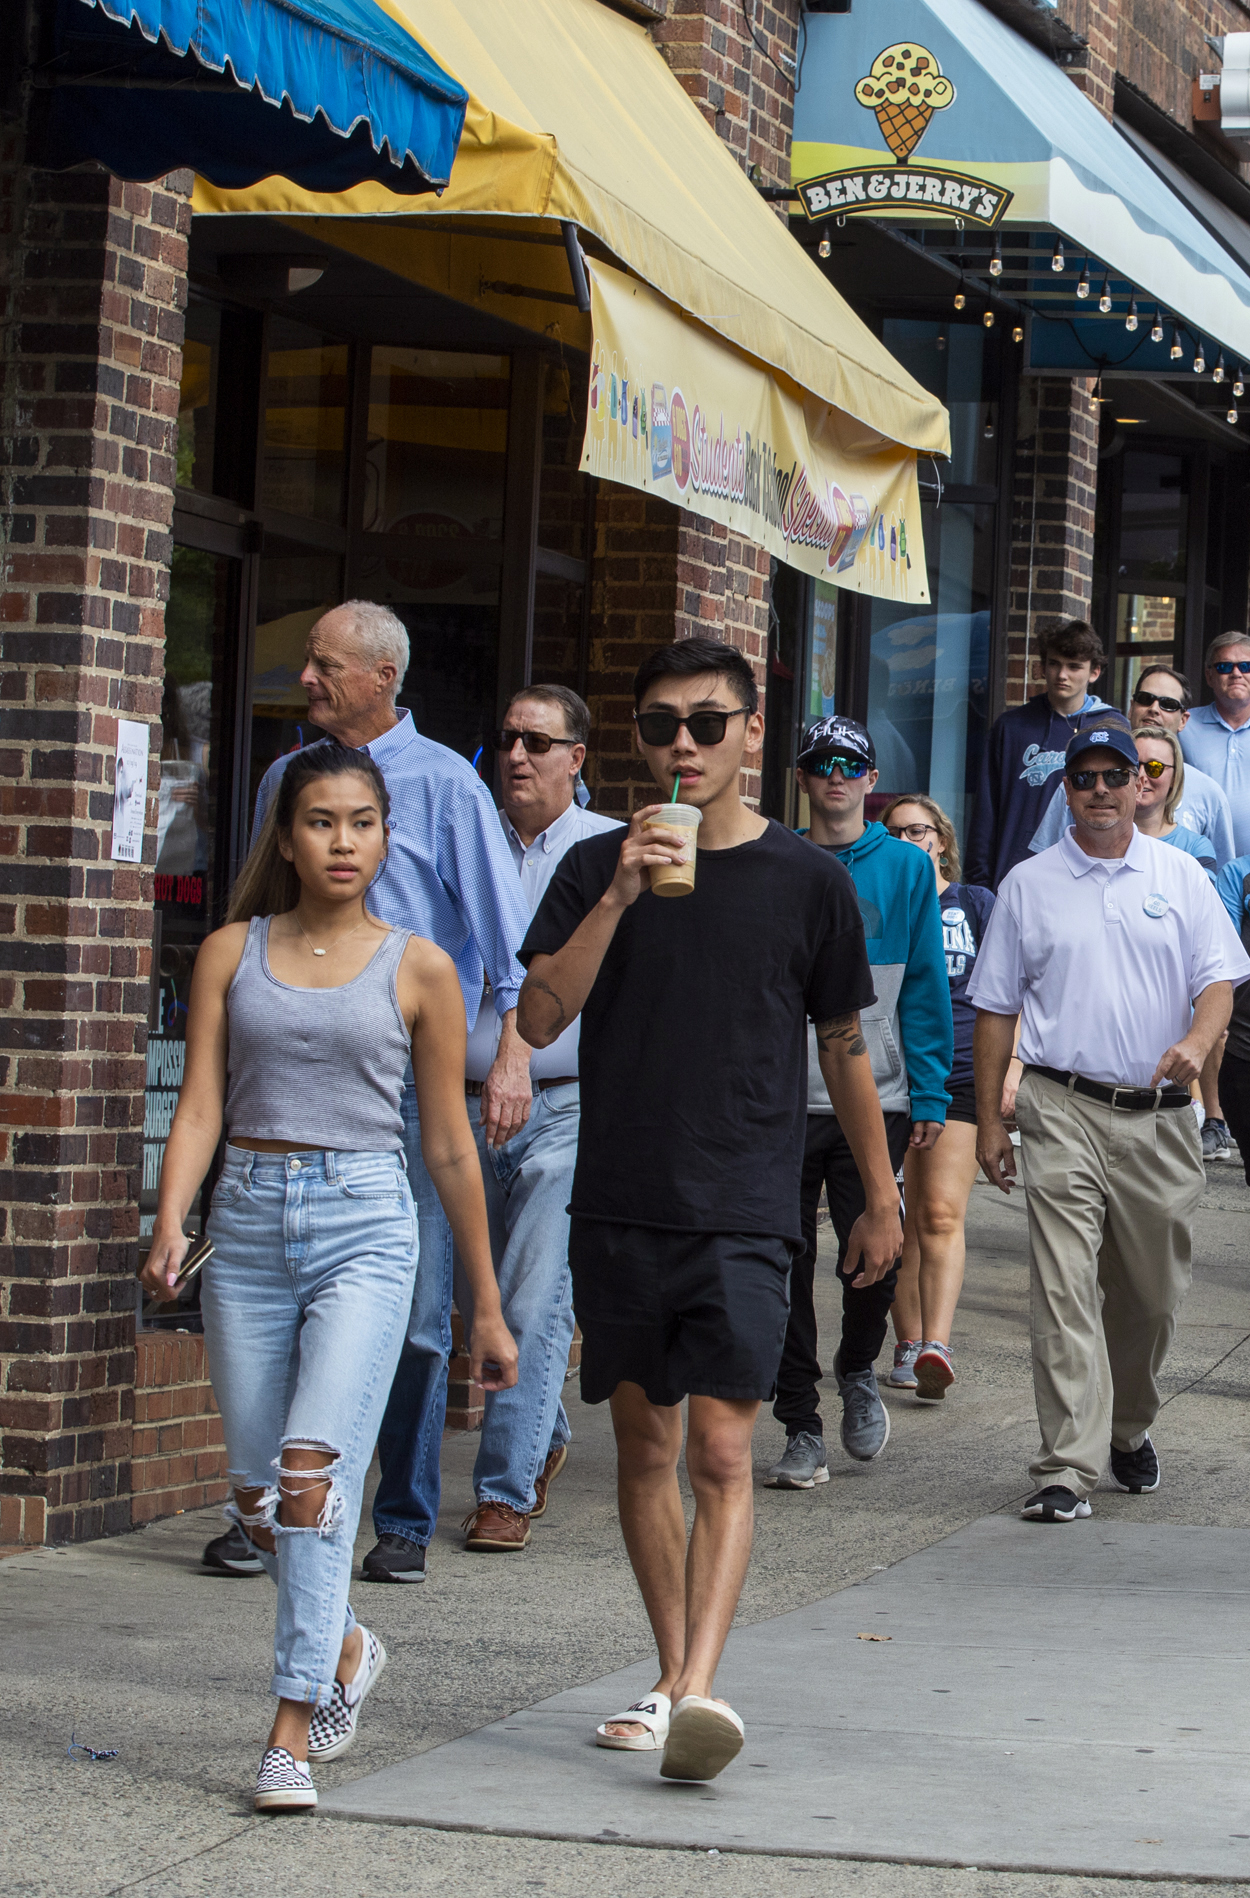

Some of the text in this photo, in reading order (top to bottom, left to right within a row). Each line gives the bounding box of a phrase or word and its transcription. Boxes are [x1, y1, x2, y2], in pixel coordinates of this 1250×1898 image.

[806, 176, 866, 212] BEN
[154, 873, 202, 904] HOT DOGS
